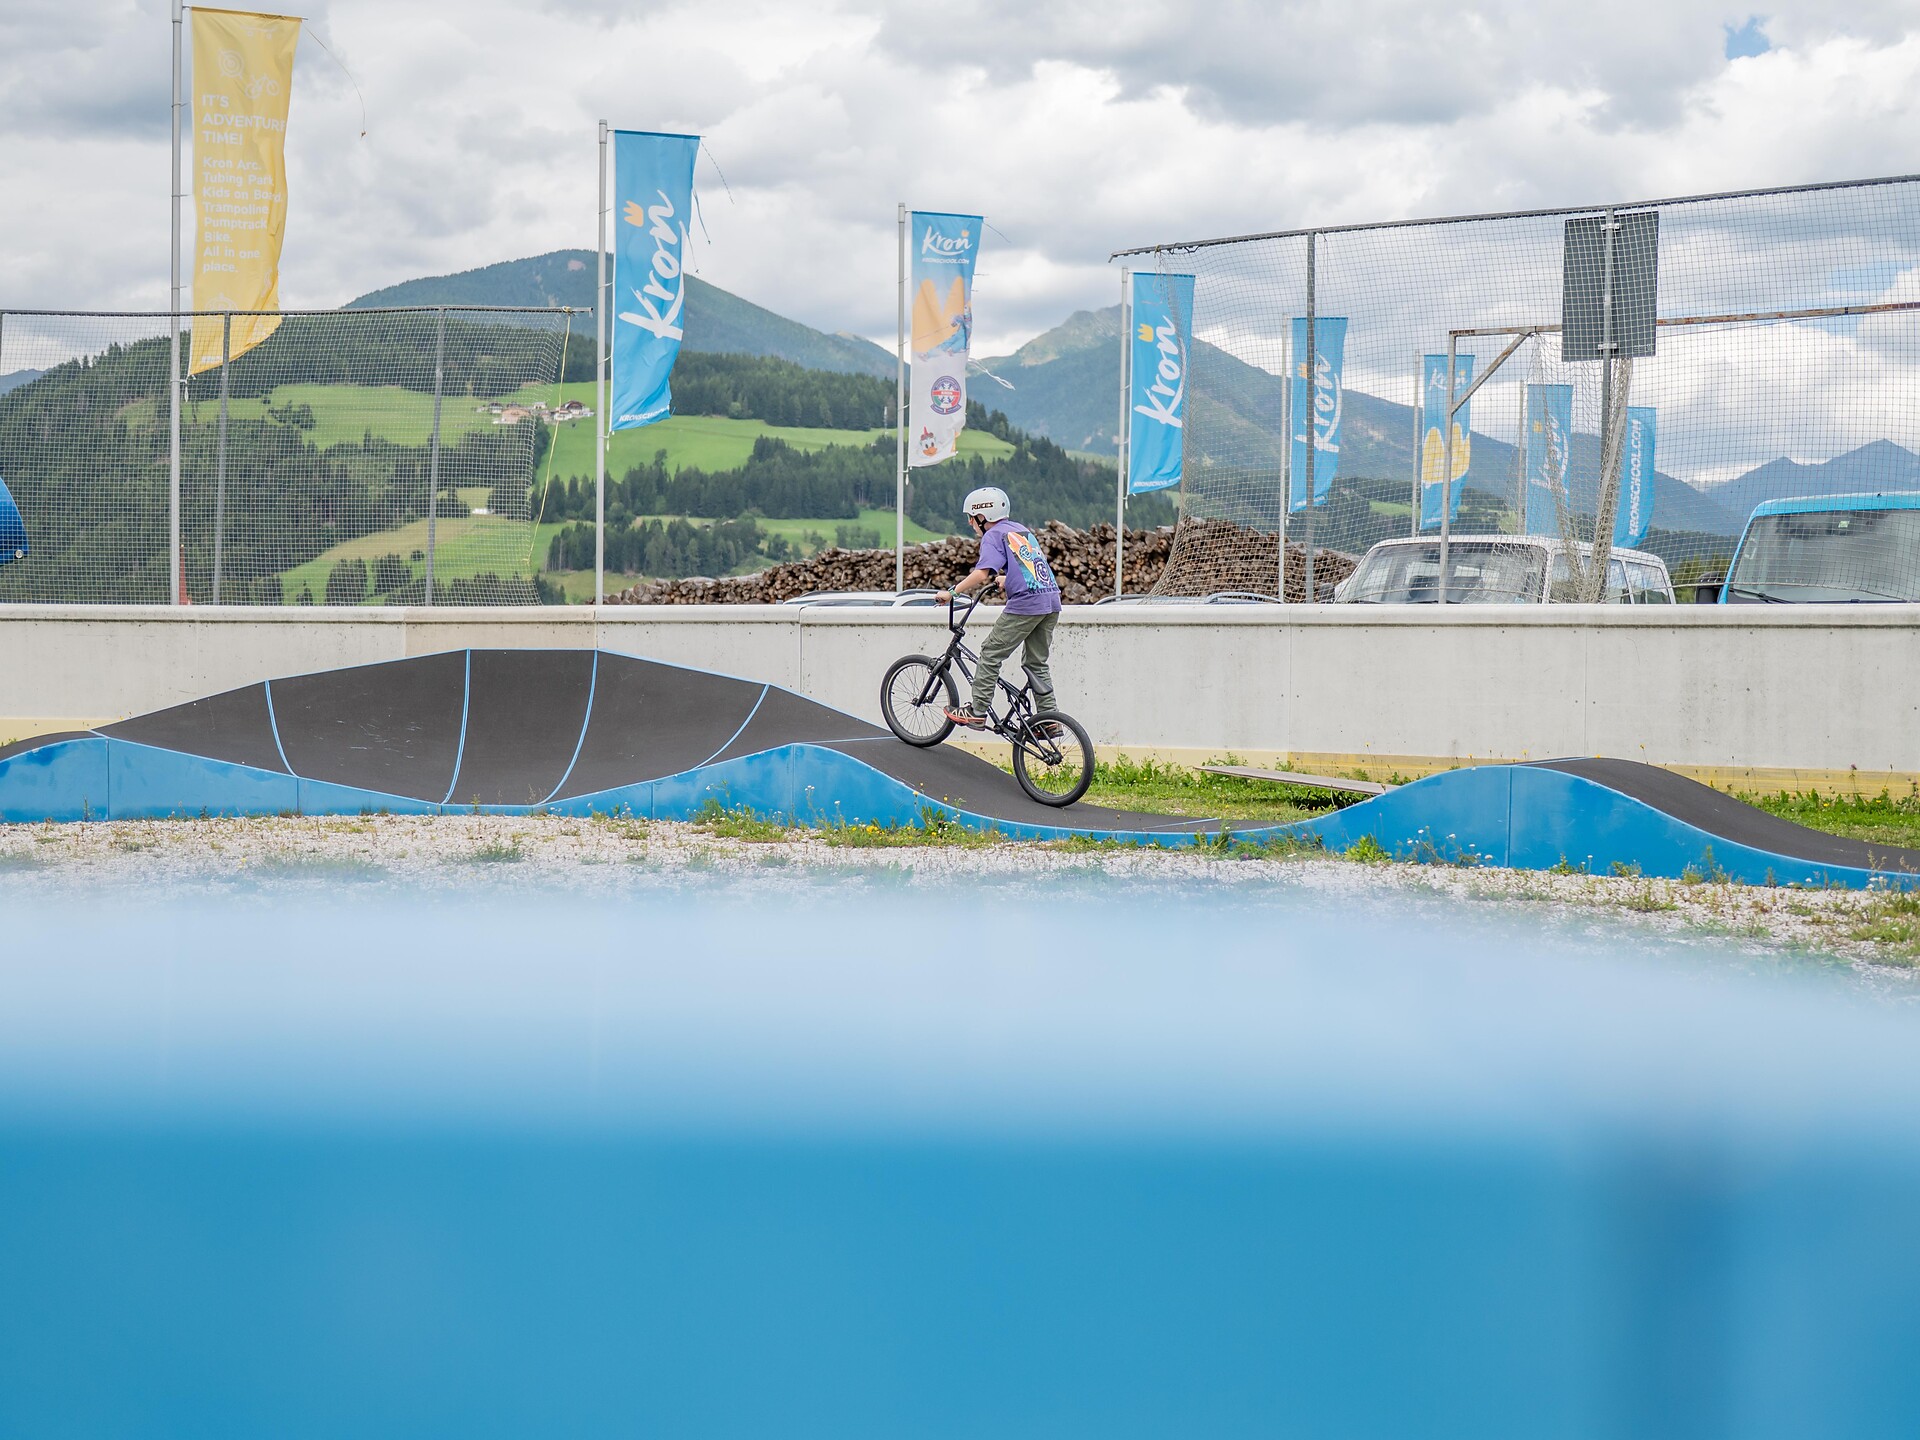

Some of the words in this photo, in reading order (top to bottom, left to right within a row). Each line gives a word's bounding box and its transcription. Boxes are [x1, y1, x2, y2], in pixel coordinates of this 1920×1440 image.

[202, 94, 230, 108] IT'S
[202, 131, 243, 145] TIME!
[203, 156, 233, 169] Kron
[203, 172, 243, 187] Tubing
[203, 187, 230, 199] Kids
[204, 231, 232, 243] Bike.
[922, 225, 973, 256] Kron
[203, 245, 219, 257] All
[225, 245, 235, 257] in
[239, 249, 260, 259] one
[203, 260, 238, 274] place.
[618, 189, 685, 341] Kron
[1134, 315, 1187, 428] Kron
[972, 502, 994, 510] ROCES
